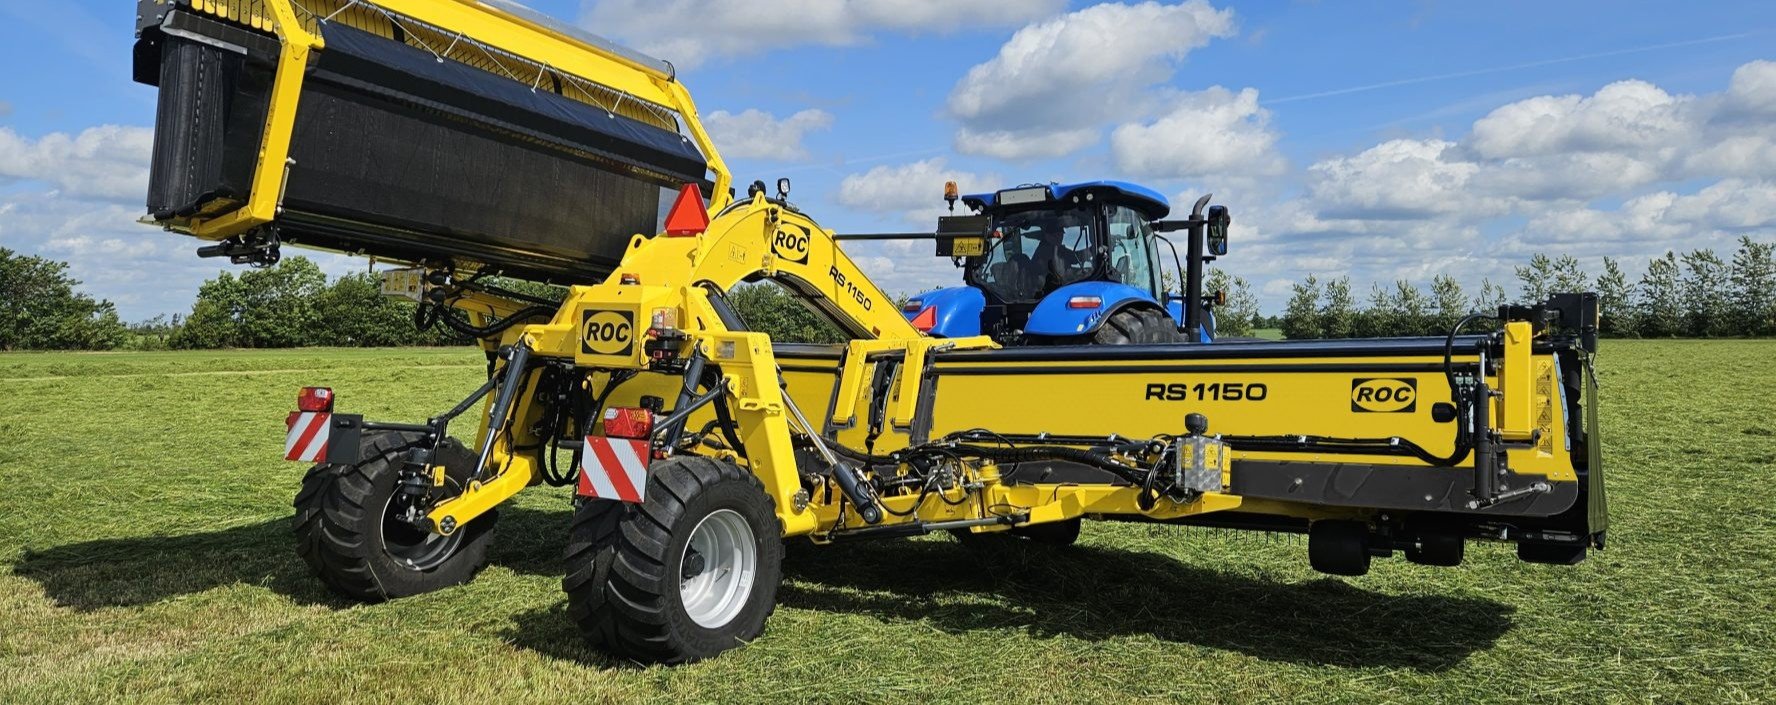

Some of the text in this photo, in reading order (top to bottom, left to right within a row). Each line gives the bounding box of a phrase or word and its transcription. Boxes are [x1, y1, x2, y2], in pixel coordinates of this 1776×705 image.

[775, 230, 807, 252] ROC
[829, 265, 872, 311] RS 1150
[586, 322, 630, 342] ROC
[1145, 383, 1267, 401] RS 1150
[1356, 386, 1411, 402] ROC
